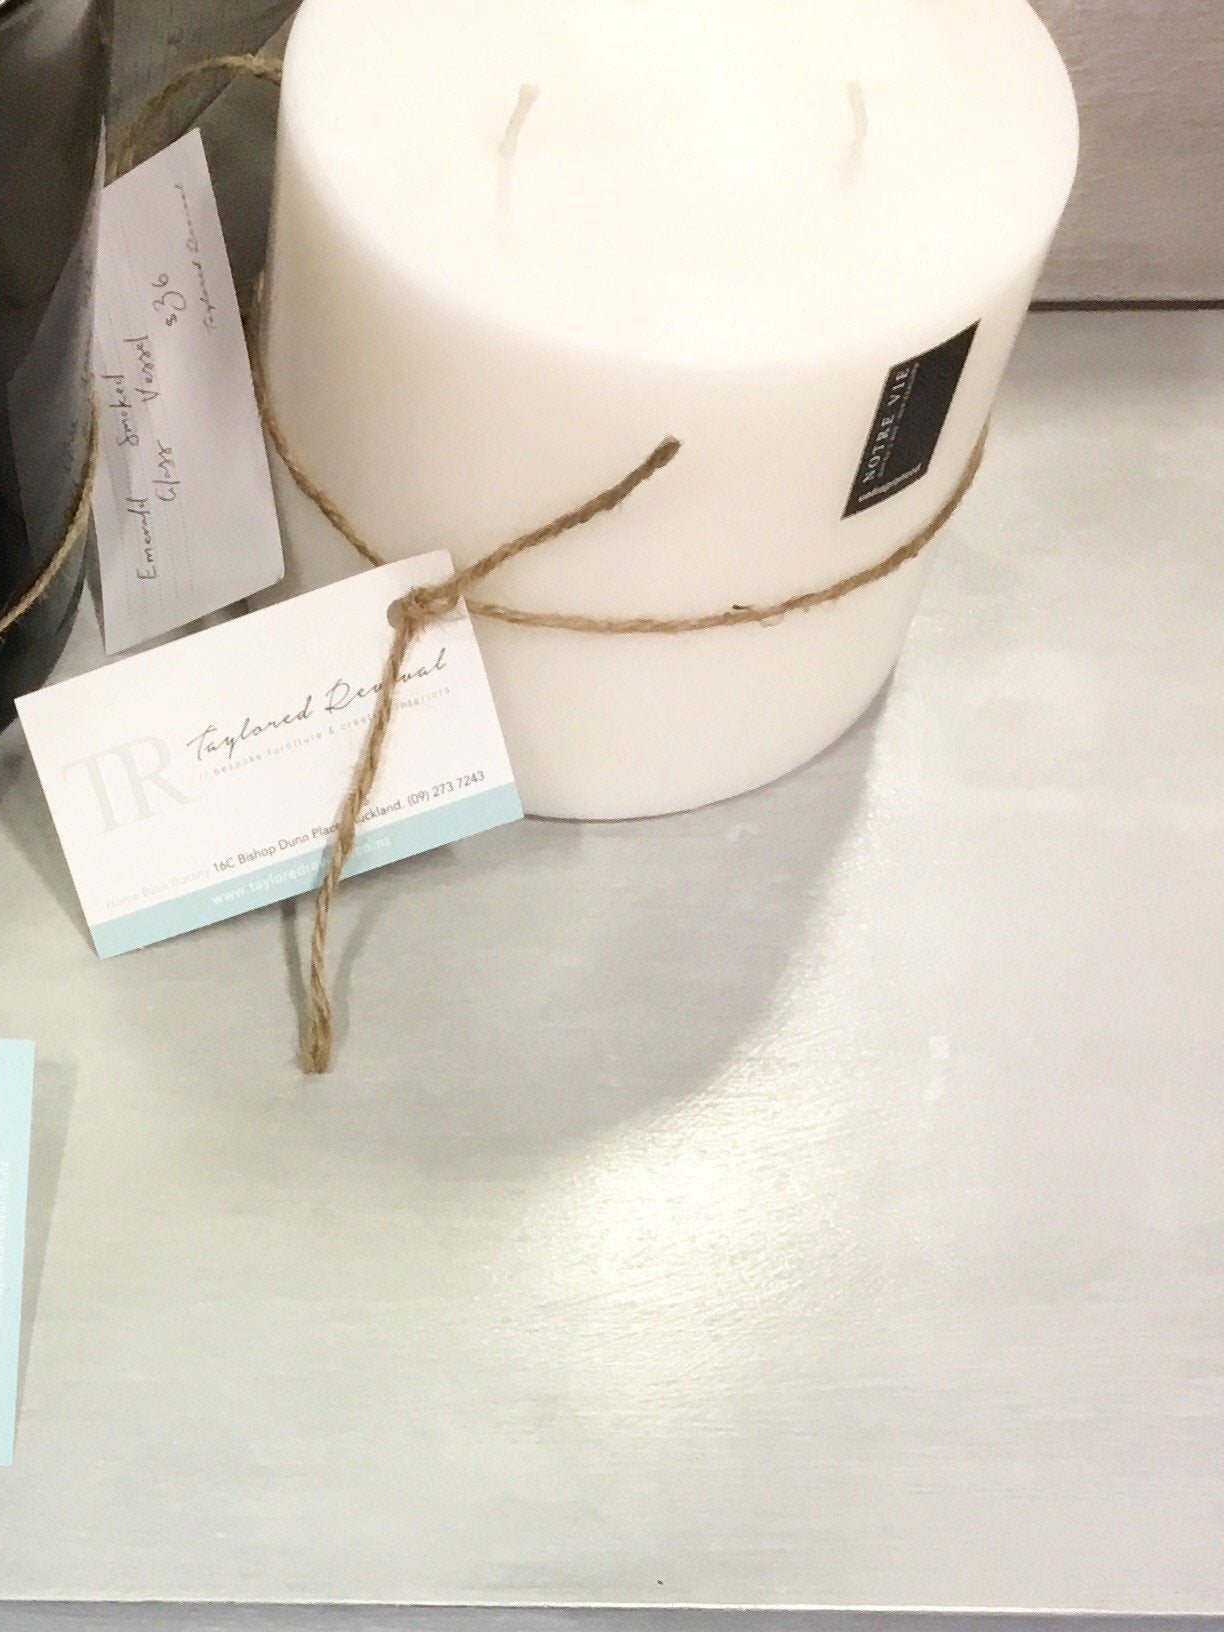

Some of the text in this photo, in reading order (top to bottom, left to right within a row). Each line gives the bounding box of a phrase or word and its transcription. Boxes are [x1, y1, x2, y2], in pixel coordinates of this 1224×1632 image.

[122, 335, 163, 404] Vessel
[101, 372, 158, 581] Emerald Smoked
[186, 647, 447, 762] Taylored Revval
[60, 735, 200, 833] TR
[212, 857, 236, 873] 16C
[237, 844, 277, 865] Bishop
[278, 833, 310, 851] Dunn
[407, 790, 430, 807] (09)
[431, 781, 454, 798] 273
[456, 770, 485, 788] 7243
